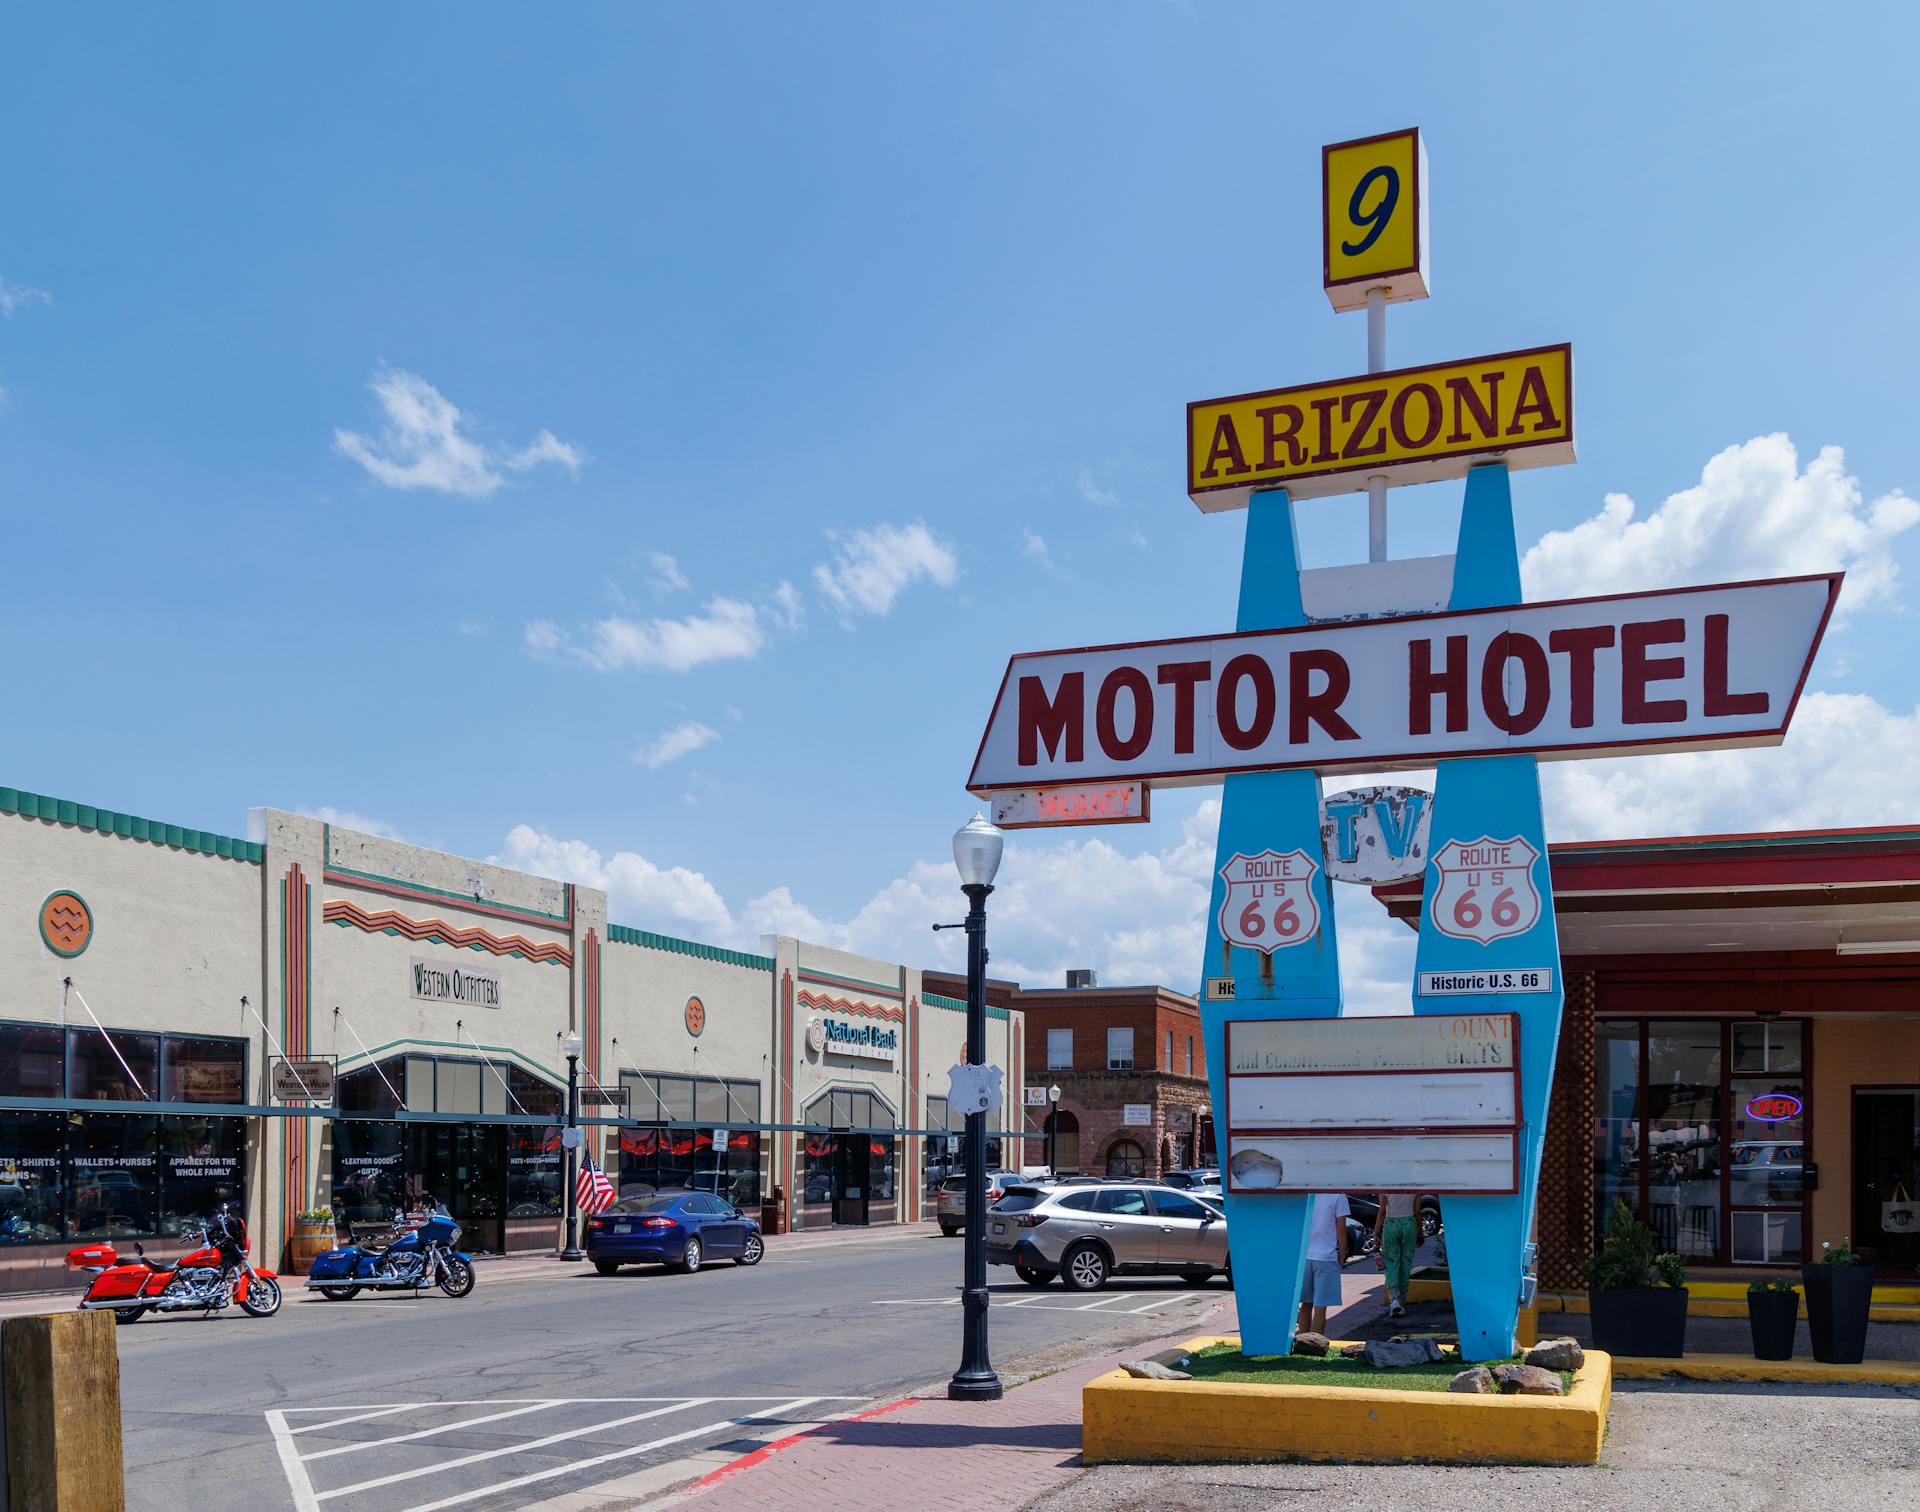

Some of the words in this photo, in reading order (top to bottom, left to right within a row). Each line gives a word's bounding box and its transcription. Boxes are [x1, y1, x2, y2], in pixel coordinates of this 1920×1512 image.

[1342, 165, 1400, 257] 9
[1200, 365, 1562, 480] ARIZONA
[1018, 649, 1362, 766] MOTOR
[1409, 614, 1770, 736] HOTEL
[1037, 788, 1132, 818] VACANCY
[1326, 795, 1427, 863] TV
[1245, 860, 1292, 878] ROUTE
[1460, 847, 1511, 866] ROUTE
[1239, 898, 1300, 938] 66
[1453, 887, 1521, 929] 66
[414, 963, 451, 999] WESTERN
[453, 969, 499, 1005] OUTFITTERS
[1431, 976, 1485, 990] Historic
[1489, 973, 1517, 988] U.S.
[1521, 973, 1539, 987] 66
[825, 1019, 871, 1044] National
[873, 1027, 897, 1049] Bank
[1750, 1099, 1797, 1117] OPEN
[22, 1158, 55, 1167] SHIRTS
[74, 1158, 114, 1167] WALLETS
[119, 1158, 152, 1167] PURSES
[169, 1158, 204, 1166] APPAREL
[205, 1158, 221, 1166] FOR
[222, 1158, 237, 1166] THE
[176, 1168, 203, 1177] WHOLE
[204, 1168, 231, 1176] FAMILY
